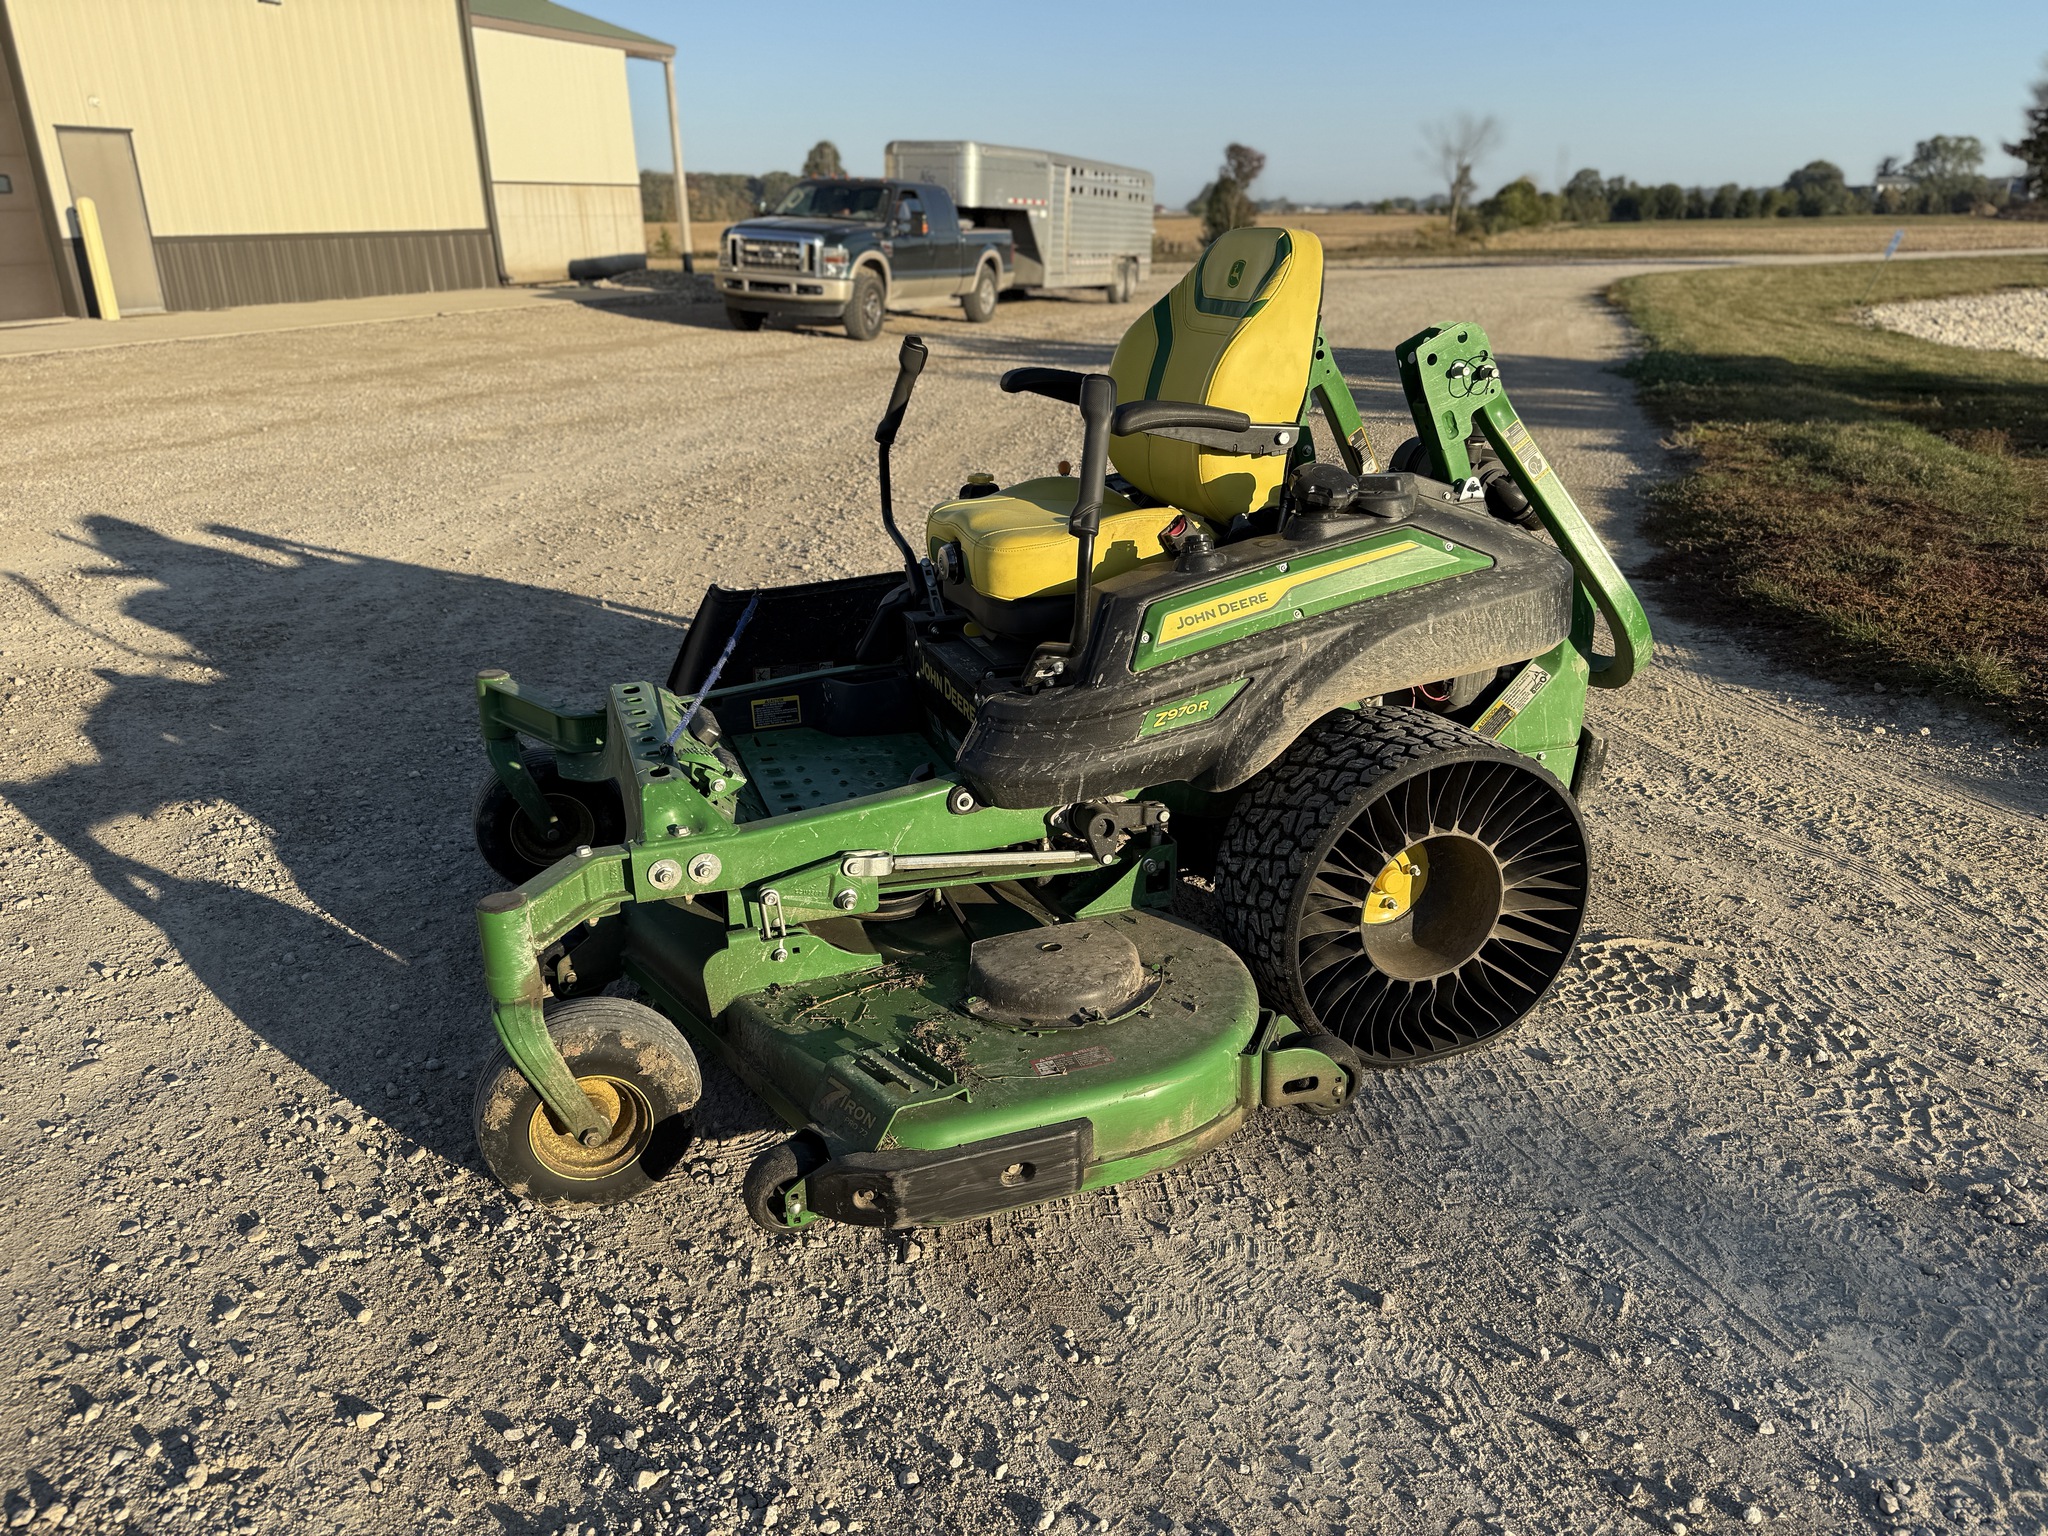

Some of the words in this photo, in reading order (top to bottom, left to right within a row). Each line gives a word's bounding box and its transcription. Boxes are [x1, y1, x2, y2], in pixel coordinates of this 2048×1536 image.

[1176, 608, 1217, 630] JOHN
[1217, 592, 1269, 616] DEERE
[920, 655, 943, 694] JOHN
[944, 676, 976, 723] DEERE
[1153, 700, 1210, 728] Z970R
[844, 1116, 859, 1130] PRO
